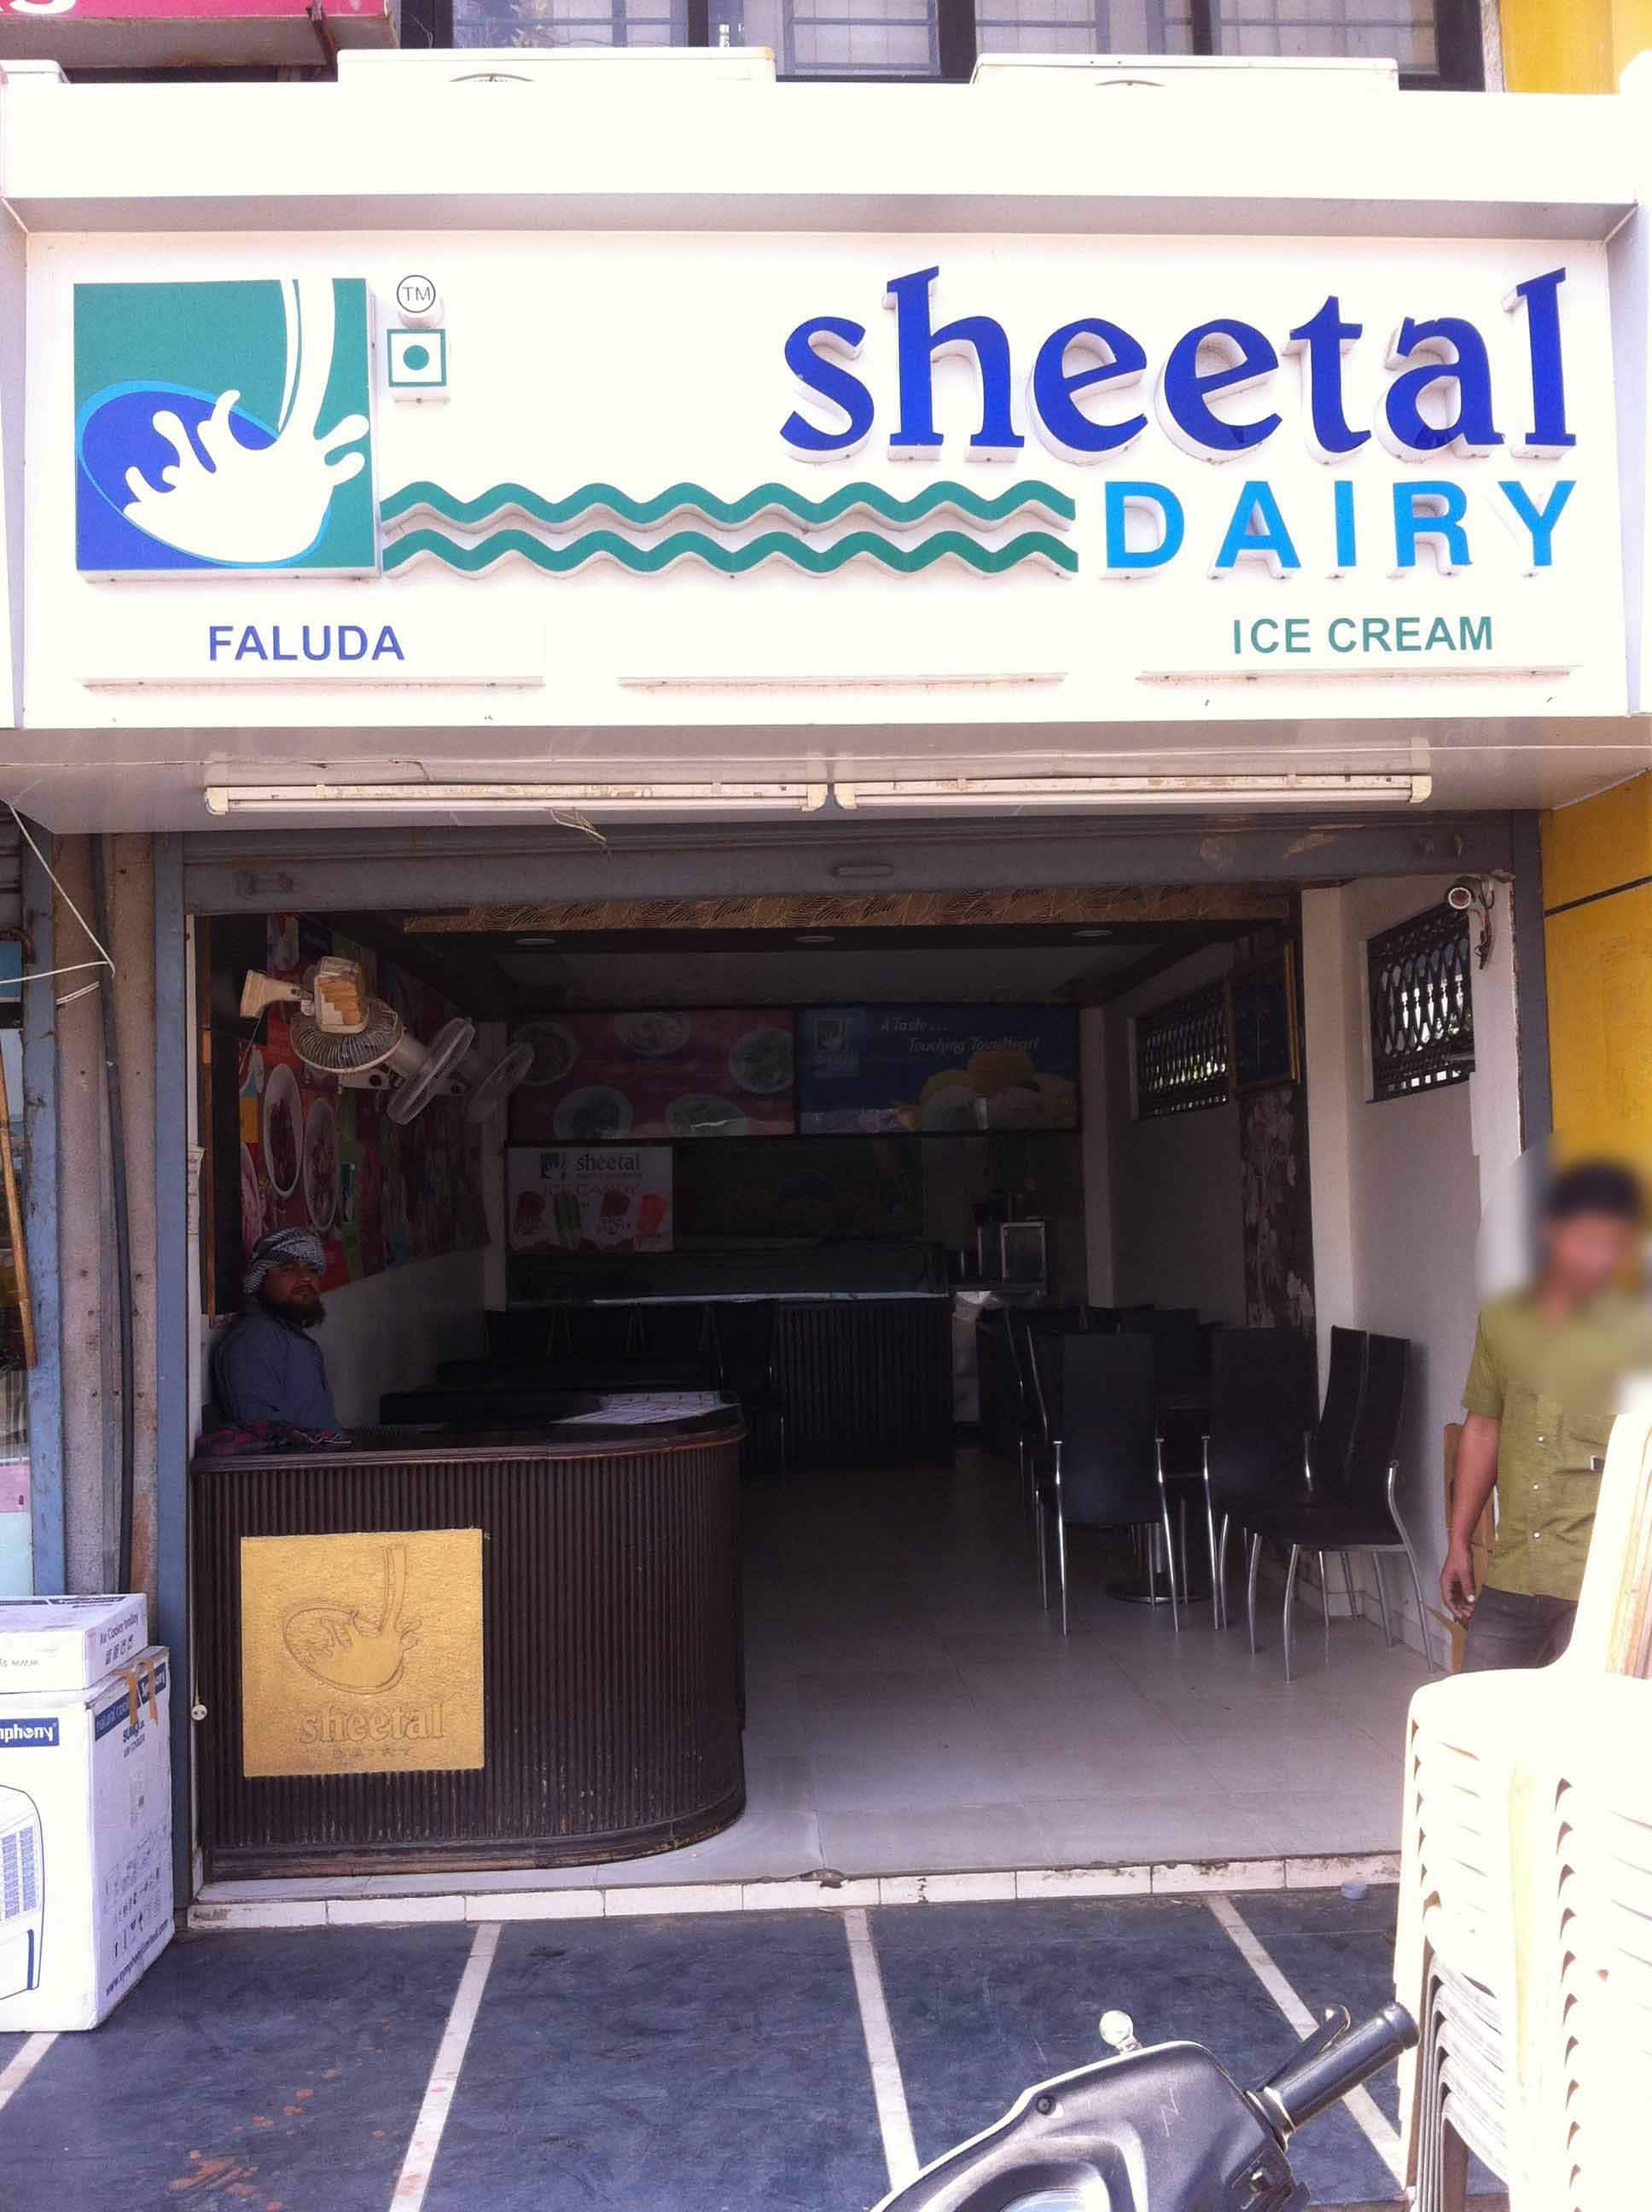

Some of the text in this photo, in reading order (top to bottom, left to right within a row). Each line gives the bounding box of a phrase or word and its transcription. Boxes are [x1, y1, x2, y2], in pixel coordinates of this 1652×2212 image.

[402, 286, 431, 301] TM
[780, 267, 1577, 452] sheetal
[1103, 480, 1577, 570] DAIRY
[209, 626, 405, 661] FALUDA
[1232, 615, 1493, 655] ICE CREAM
[300, 1703, 445, 1743] sheetal
